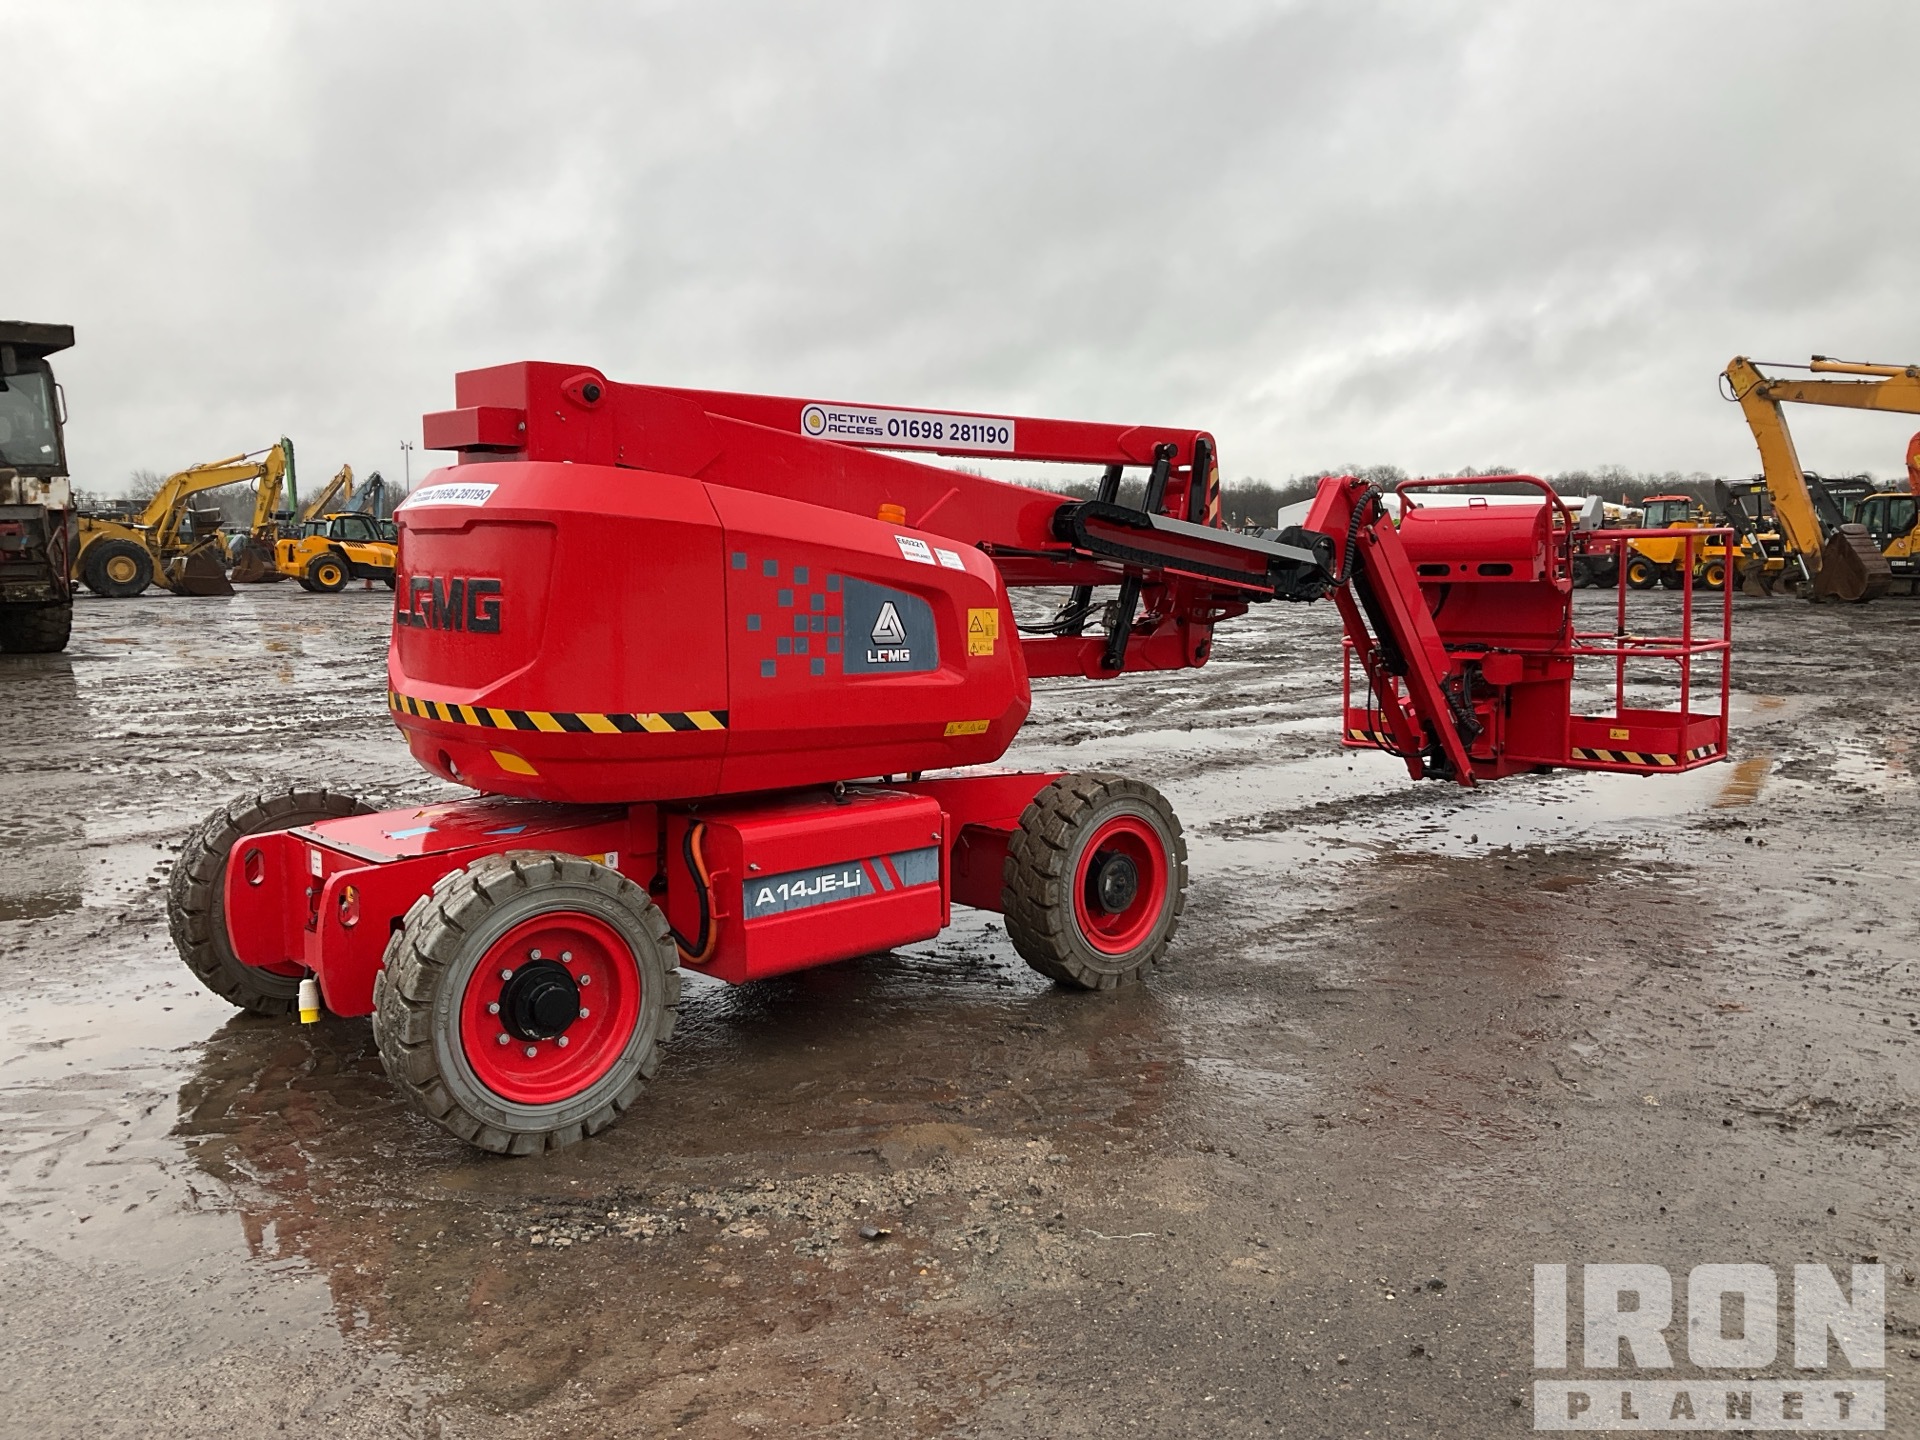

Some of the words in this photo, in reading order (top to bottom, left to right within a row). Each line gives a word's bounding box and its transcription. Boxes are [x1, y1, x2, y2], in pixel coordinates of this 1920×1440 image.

[828, 413, 877, 425] ACTIVE
[828, 424, 883, 436] ACCESS
[887, 418, 944, 440] 01698
[949, 422, 1009, 444] 281190
